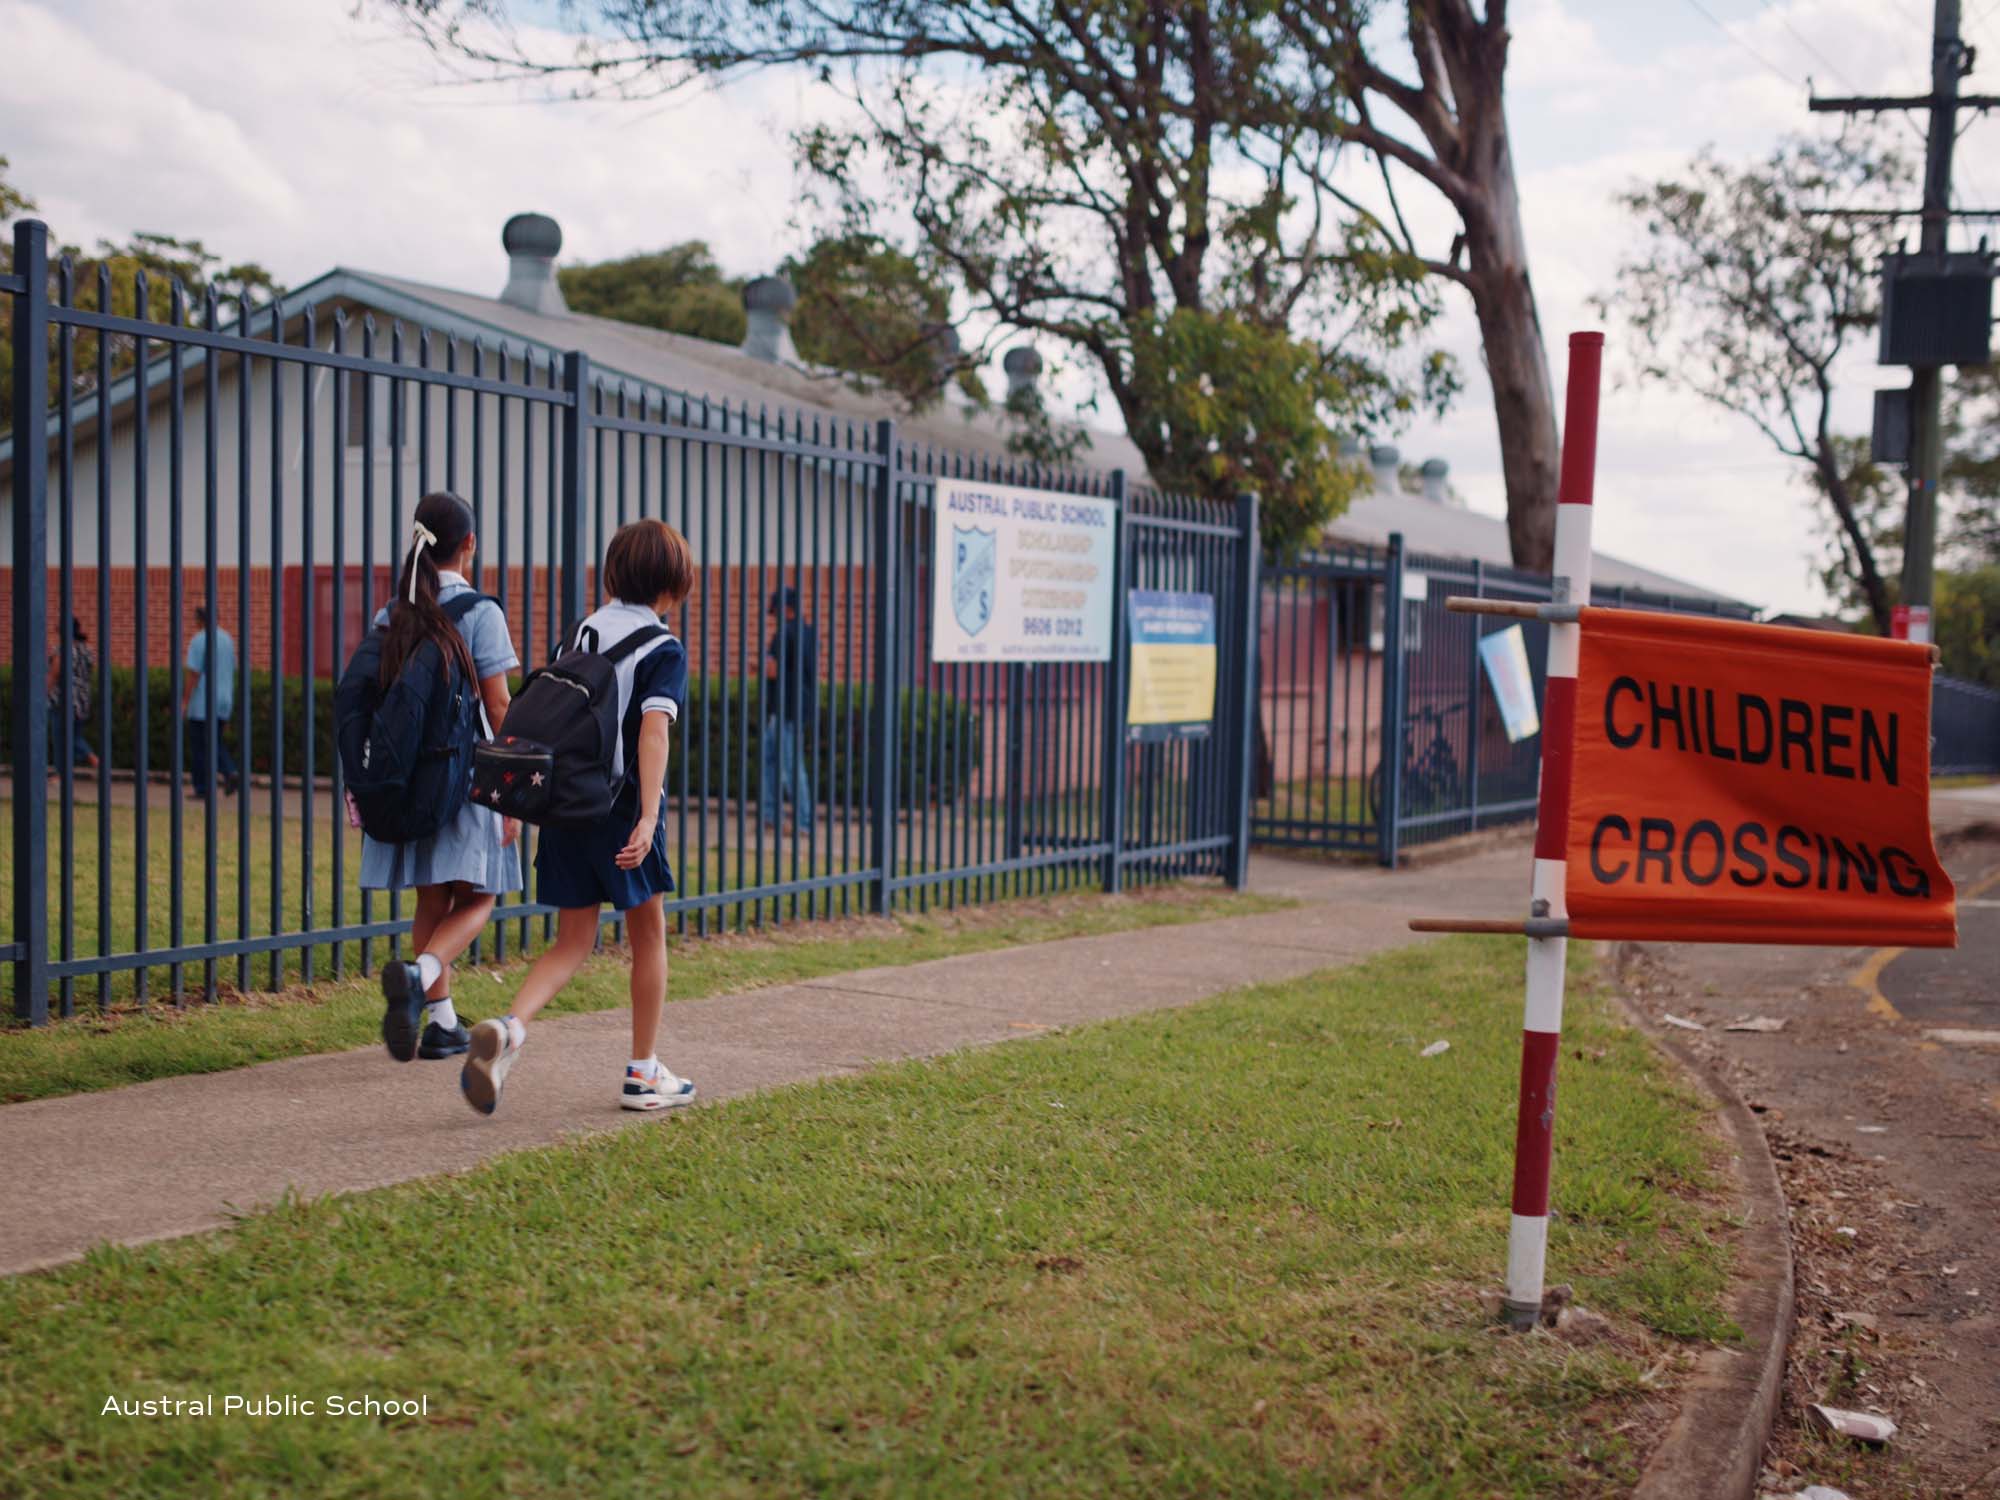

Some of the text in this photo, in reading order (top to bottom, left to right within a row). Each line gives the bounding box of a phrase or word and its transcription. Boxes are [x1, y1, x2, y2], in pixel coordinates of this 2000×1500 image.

[948, 491, 1107, 527] AUSTRAL PUBLIC SCHOOL
[979, 590, 988, 620] S
[1604, 675, 1899, 787] CHILDREN
[1589, 814, 1931, 899] CROSSING
